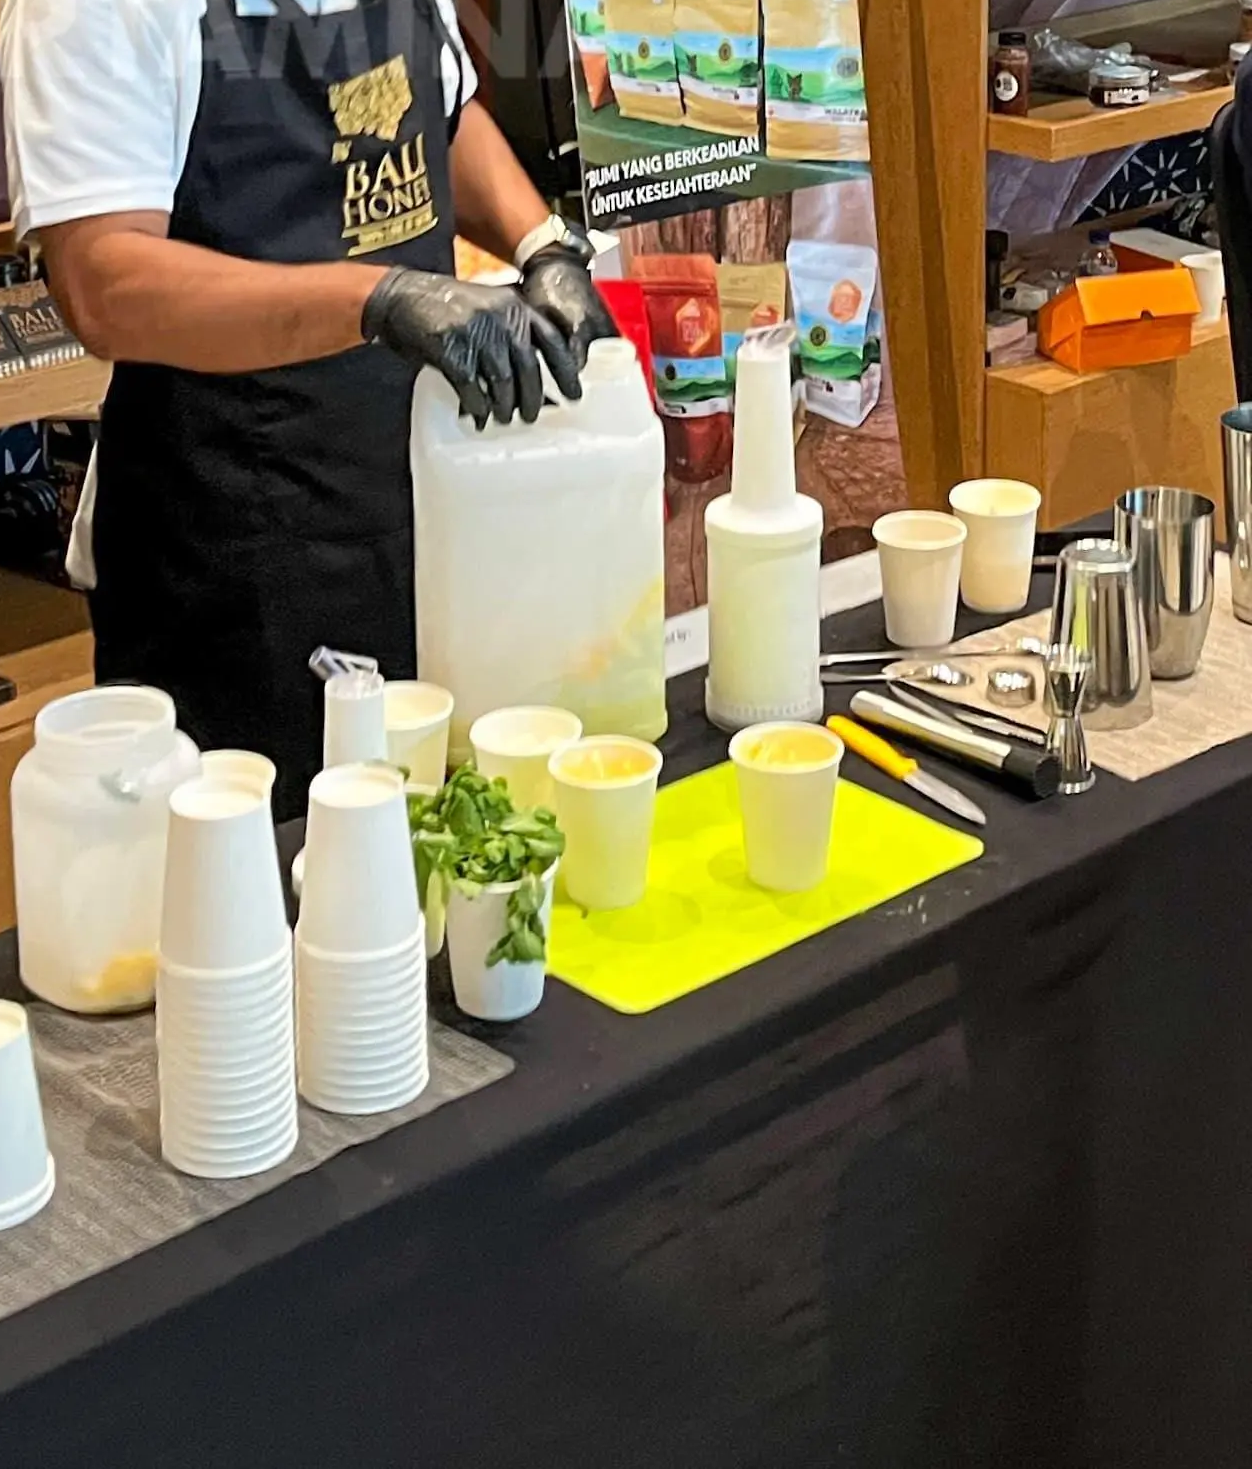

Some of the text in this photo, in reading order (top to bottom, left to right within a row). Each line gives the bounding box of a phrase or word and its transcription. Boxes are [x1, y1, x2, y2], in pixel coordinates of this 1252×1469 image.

[346, 132, 427, 201] BALI
[620, 153, 663, 180] YANG
[664, 134, 761, 171] BERKEADILAN
[590, 162, 757, 217] UNTUK KESEJAHTERAAN"
[9, 306, 58, 331] BALI
